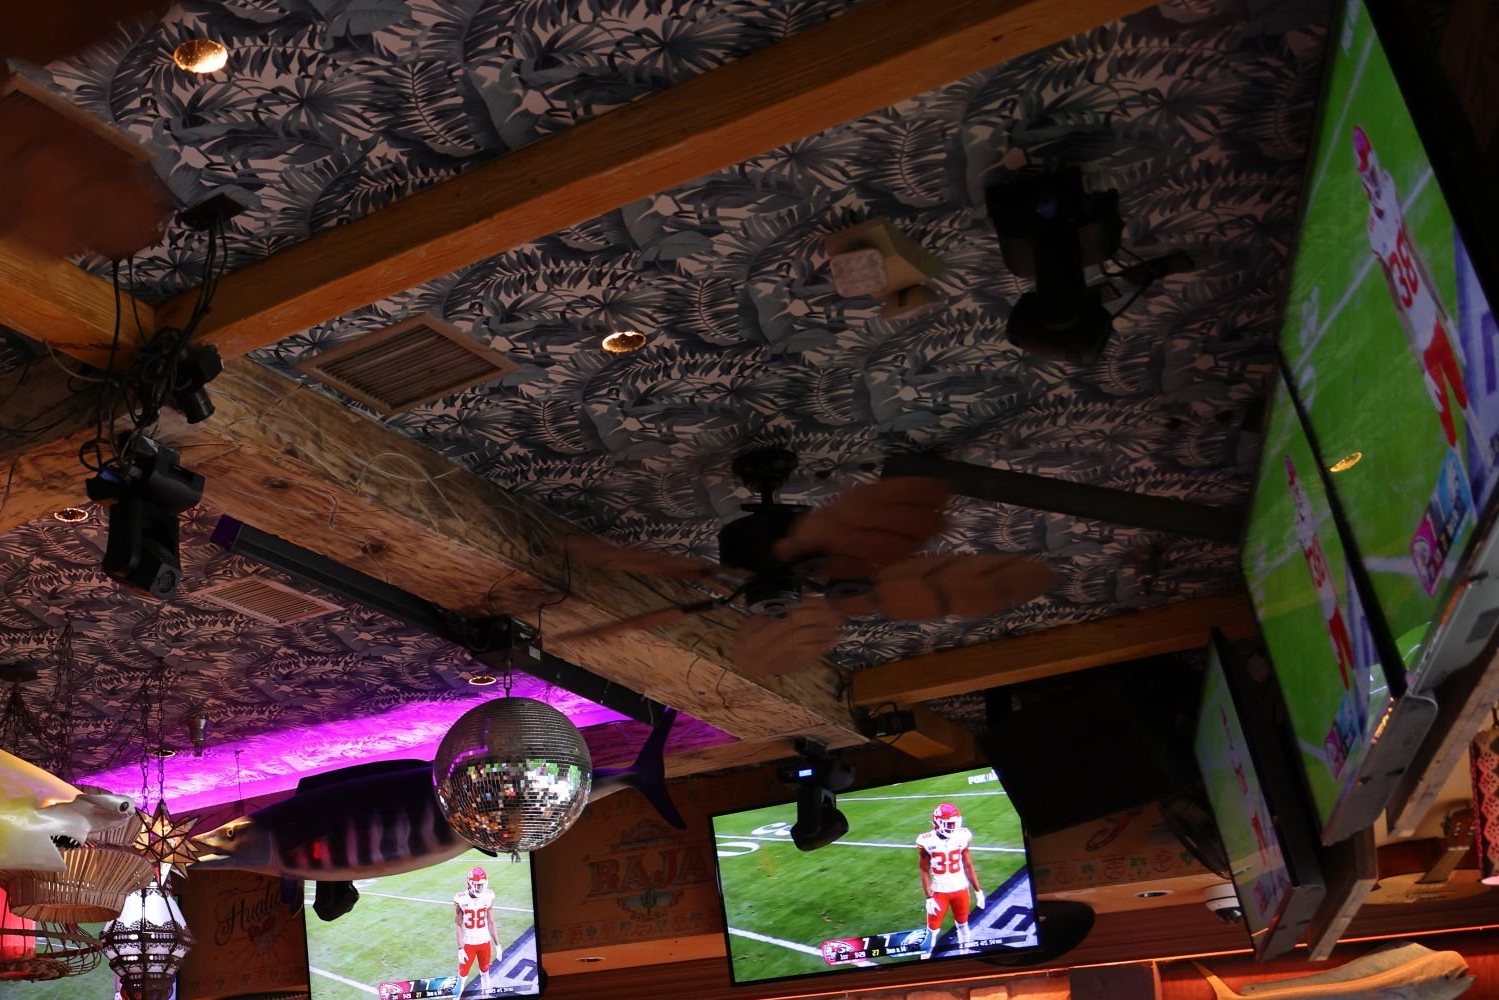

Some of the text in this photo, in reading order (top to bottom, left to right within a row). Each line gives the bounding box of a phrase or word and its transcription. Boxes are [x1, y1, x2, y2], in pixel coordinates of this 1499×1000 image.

[587, 845, 714, 898] BAJA
[932, 849, 961, 875] 38
[464, 907, 487, 929] 38
[862, 935, 891, 950] 7 7
